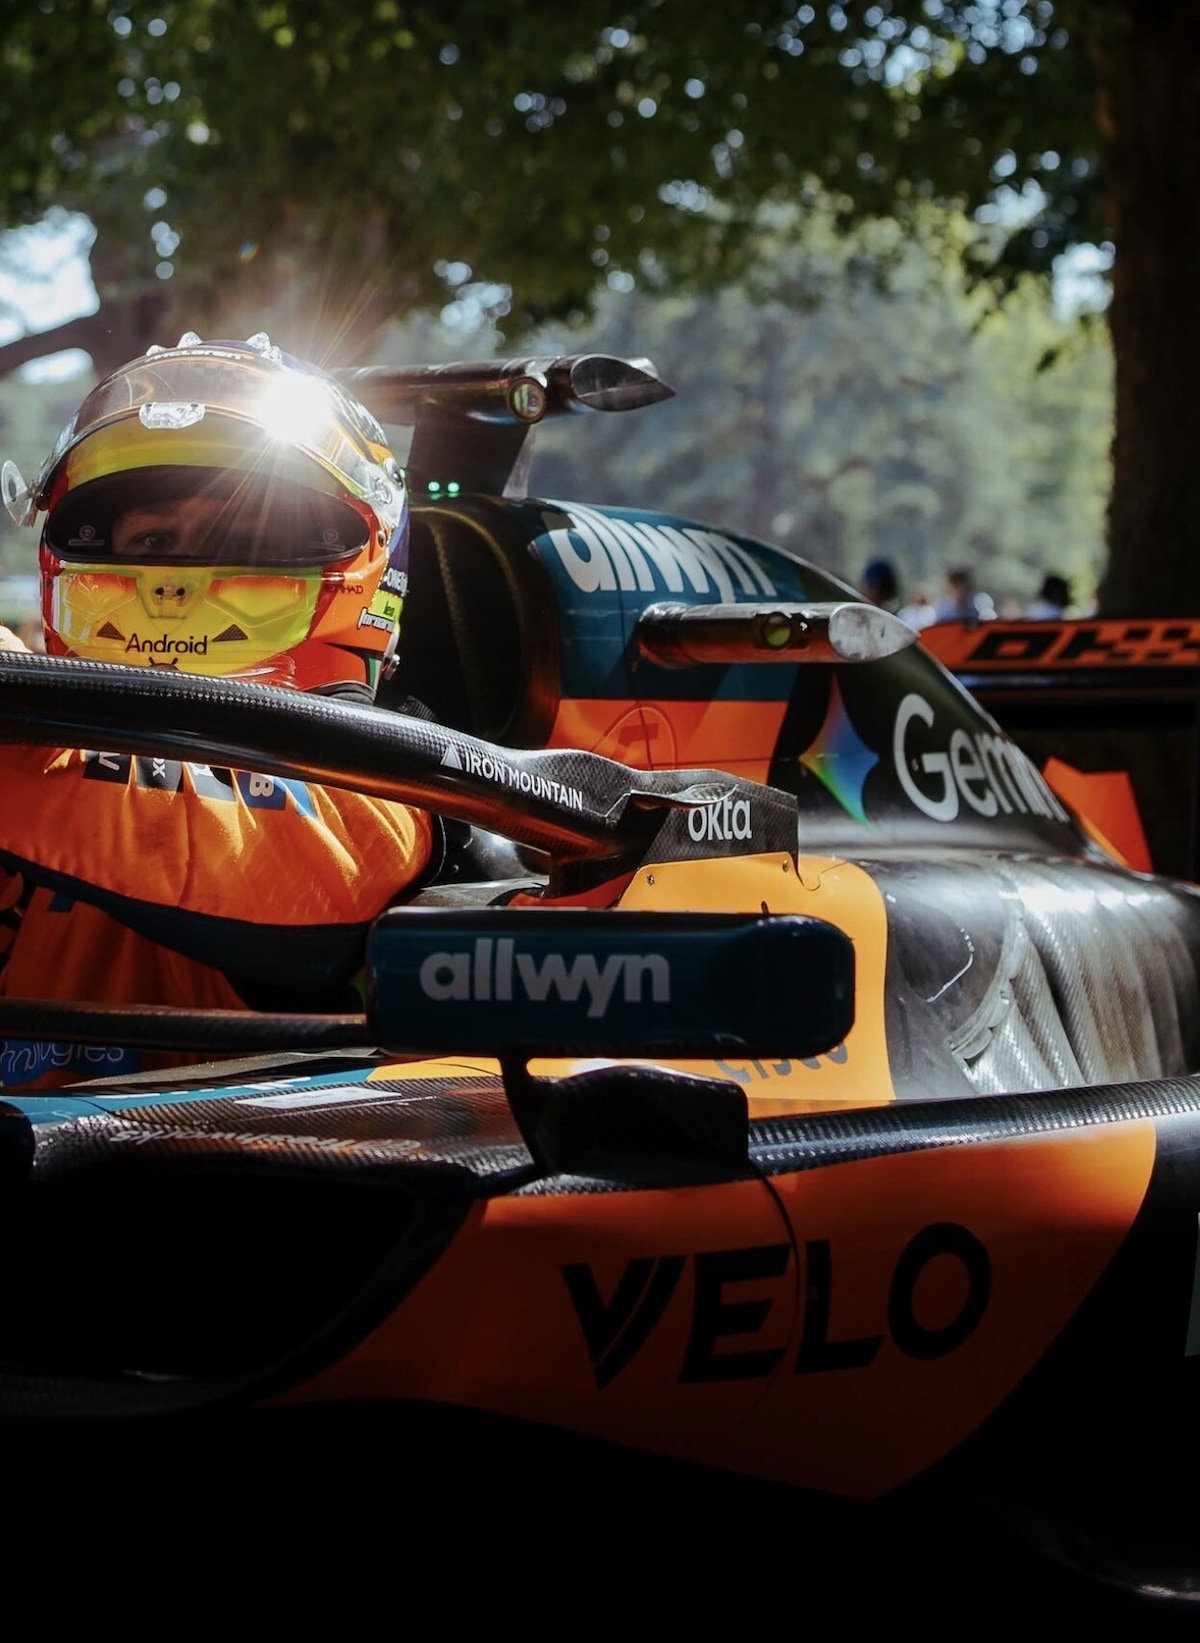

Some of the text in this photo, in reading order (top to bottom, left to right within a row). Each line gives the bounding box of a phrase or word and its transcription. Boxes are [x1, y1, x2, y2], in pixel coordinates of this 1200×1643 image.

[547, 499, 777, 603] allwyn
[125, 633, 208, 655] Android
[465, 752, 583, 811] IRON MOUNTAIN
[688, 799, 752, 842] okta
[419, 938, 671, 1019] allwyn
[559, 1221, 992, 1391] VELO
